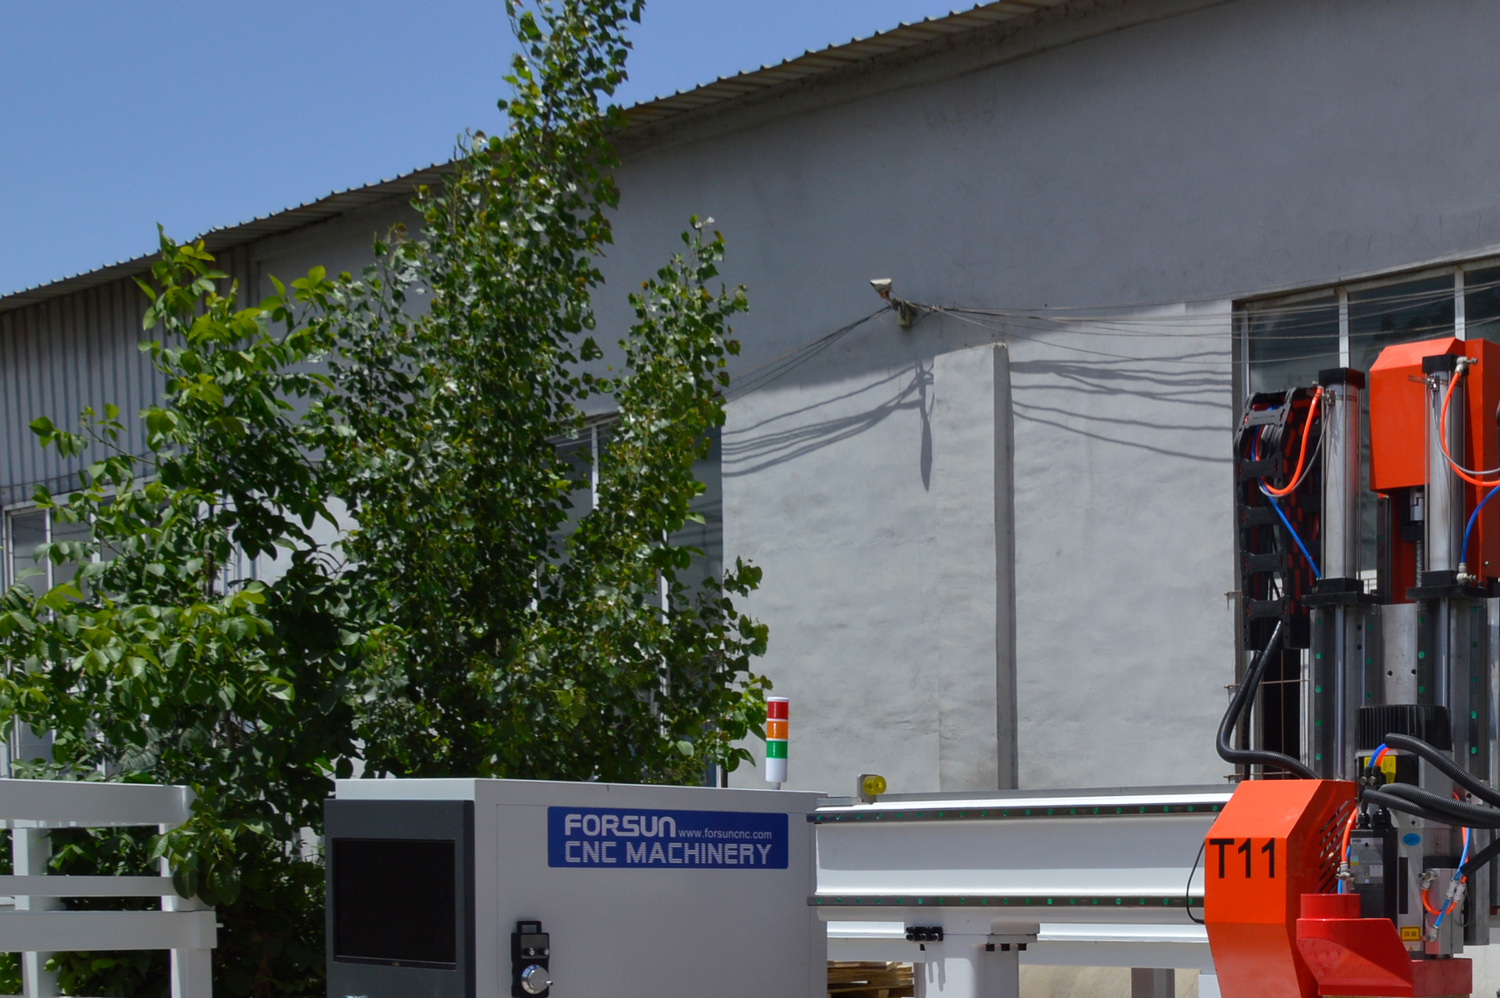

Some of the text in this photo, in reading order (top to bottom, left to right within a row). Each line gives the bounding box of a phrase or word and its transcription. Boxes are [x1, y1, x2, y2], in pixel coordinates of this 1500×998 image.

[564, 813, 772, 840] FORSUN www.forsuncnc.com
[565, 840, 772, 864] CNC MACHINERY
[1209, 837, 1275, 879] T11
